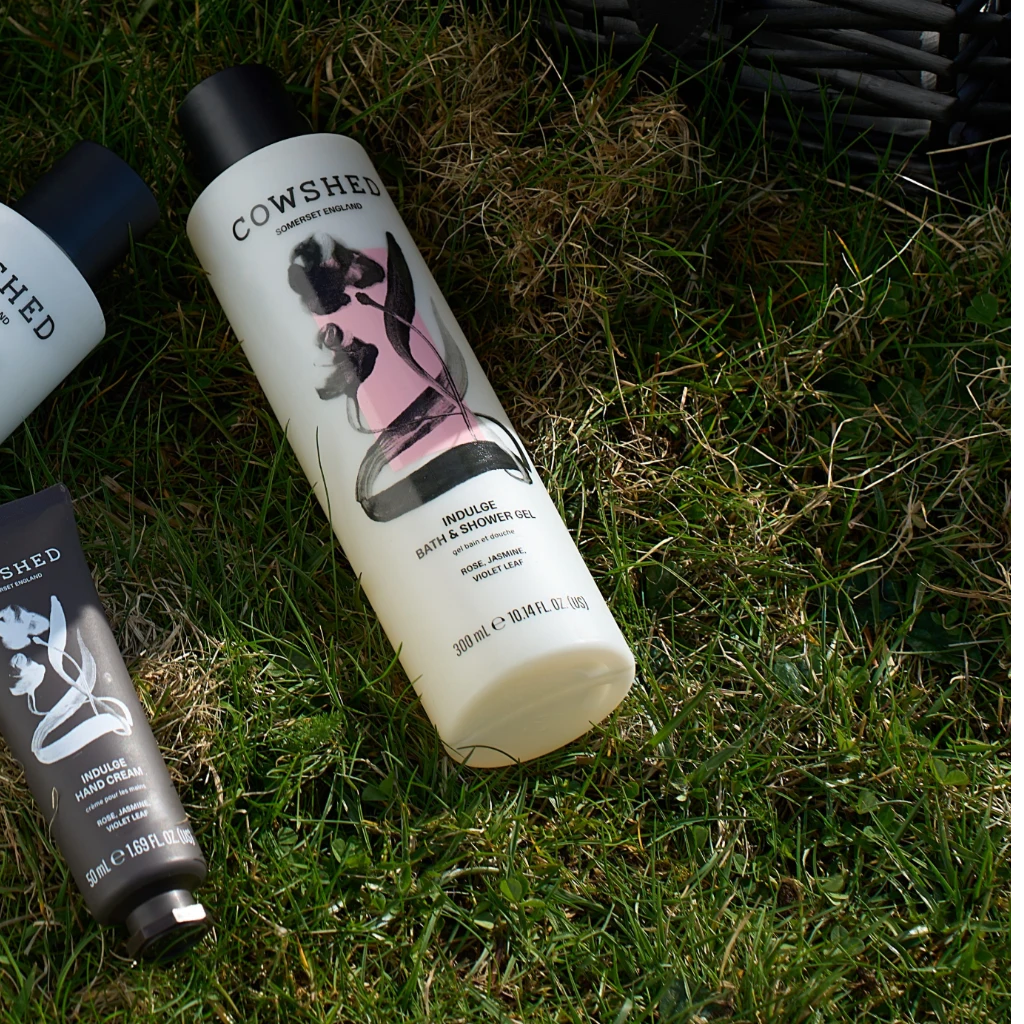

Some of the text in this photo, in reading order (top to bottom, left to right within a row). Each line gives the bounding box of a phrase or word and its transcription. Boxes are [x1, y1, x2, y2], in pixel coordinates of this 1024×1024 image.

[232, 175, 381, 241] COWSHED
[275, 202, 363, 236] SOMERSET ENGLAND
[442, 500, 498, 527] INDULGE
[415, 509, 536, 560] BATH & SHOWER GEL
[452, 528, 515, 556] gel bain et douche
[460, 547, 527, 576] ROSE, JASMINE,
[472, 559, 524, 582] VIOLET LEAF
[14, 572, 43, 587] ENGLAND
[452, 634, 474, 657] 300
[507, 604, 536, 624] 10.14
[535, 600, 552, 615] FL.
[567, 595, 590, 611] (US)
[75, 766, 144, 802] HAND CREAM
[81, 757, 128, 784] INDULGE
[85, 783, 147, 813] crème pour les mains
[96, 812, 118, 827] ROSE,
[105, 810, 149, 833] VIOLET LEAF
[85, 868, 99, 888] 50
[125, 835, 150, 858] 1.69
